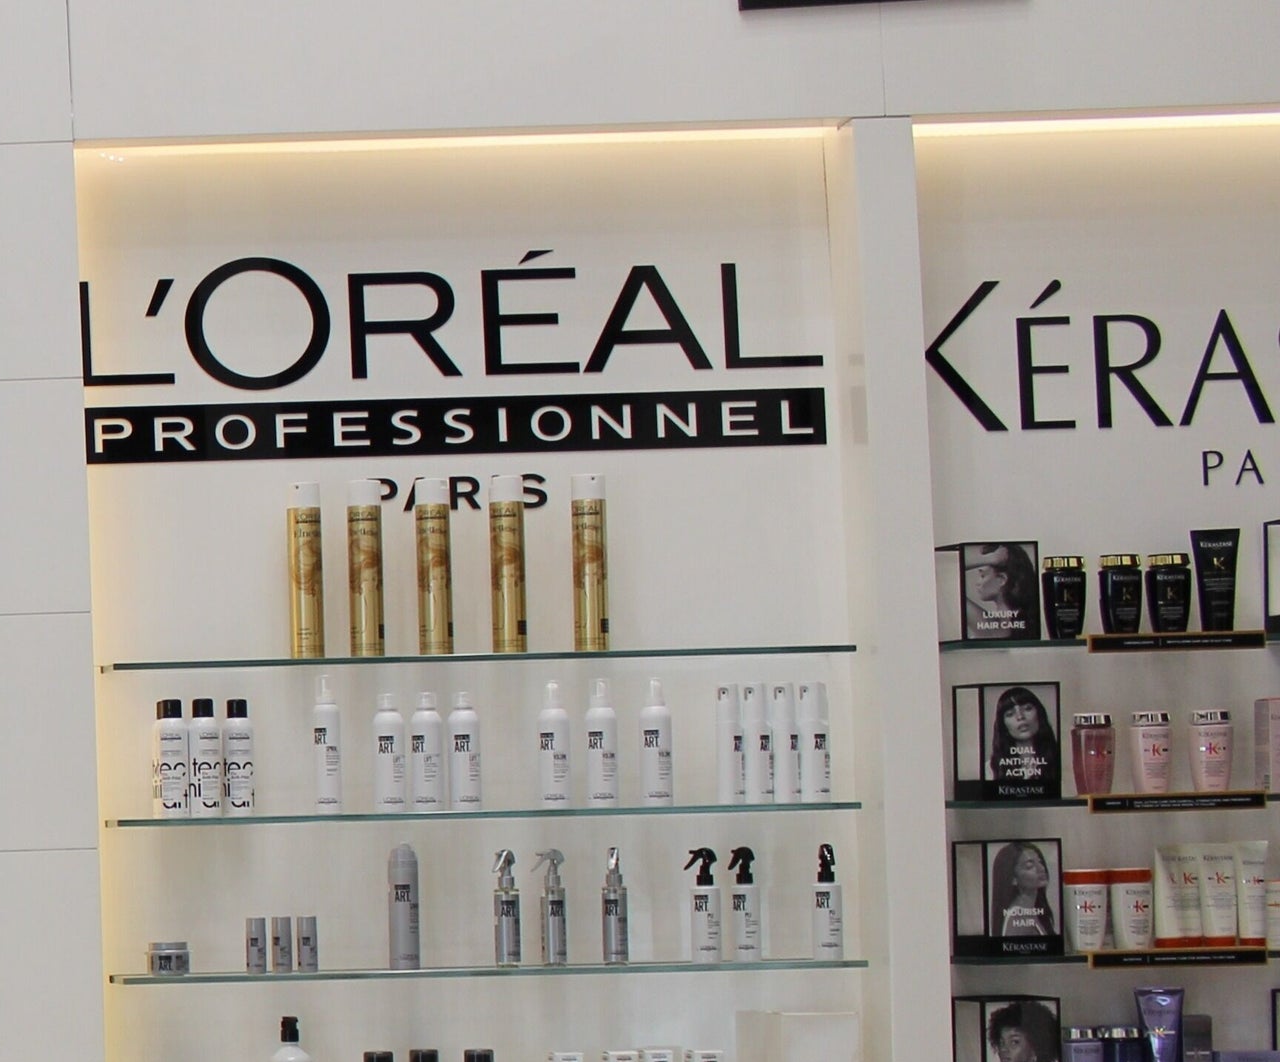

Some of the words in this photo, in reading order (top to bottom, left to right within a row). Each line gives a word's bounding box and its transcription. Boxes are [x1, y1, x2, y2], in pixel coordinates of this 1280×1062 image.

[79, 249, 824, 391] L'ORÉAL
[924, 279, 1280, 432] KÉRA
[94, 398, 817, 454] PROFESSIONNEL
[366, 473, 548, 512] PRS
[982, 610, 1019, 619] LUXURY
[977, 622, 1000, 631] HAIR
[1001, 620, 1026, 630] CARE
[1009, 747, 1036, 755] DUAL
[998, 757, 1048, 766] ANTI-FALL
[1003, 908, 1045, 917] NOURISH
[1012, 919, 1035, 927] HAIR
